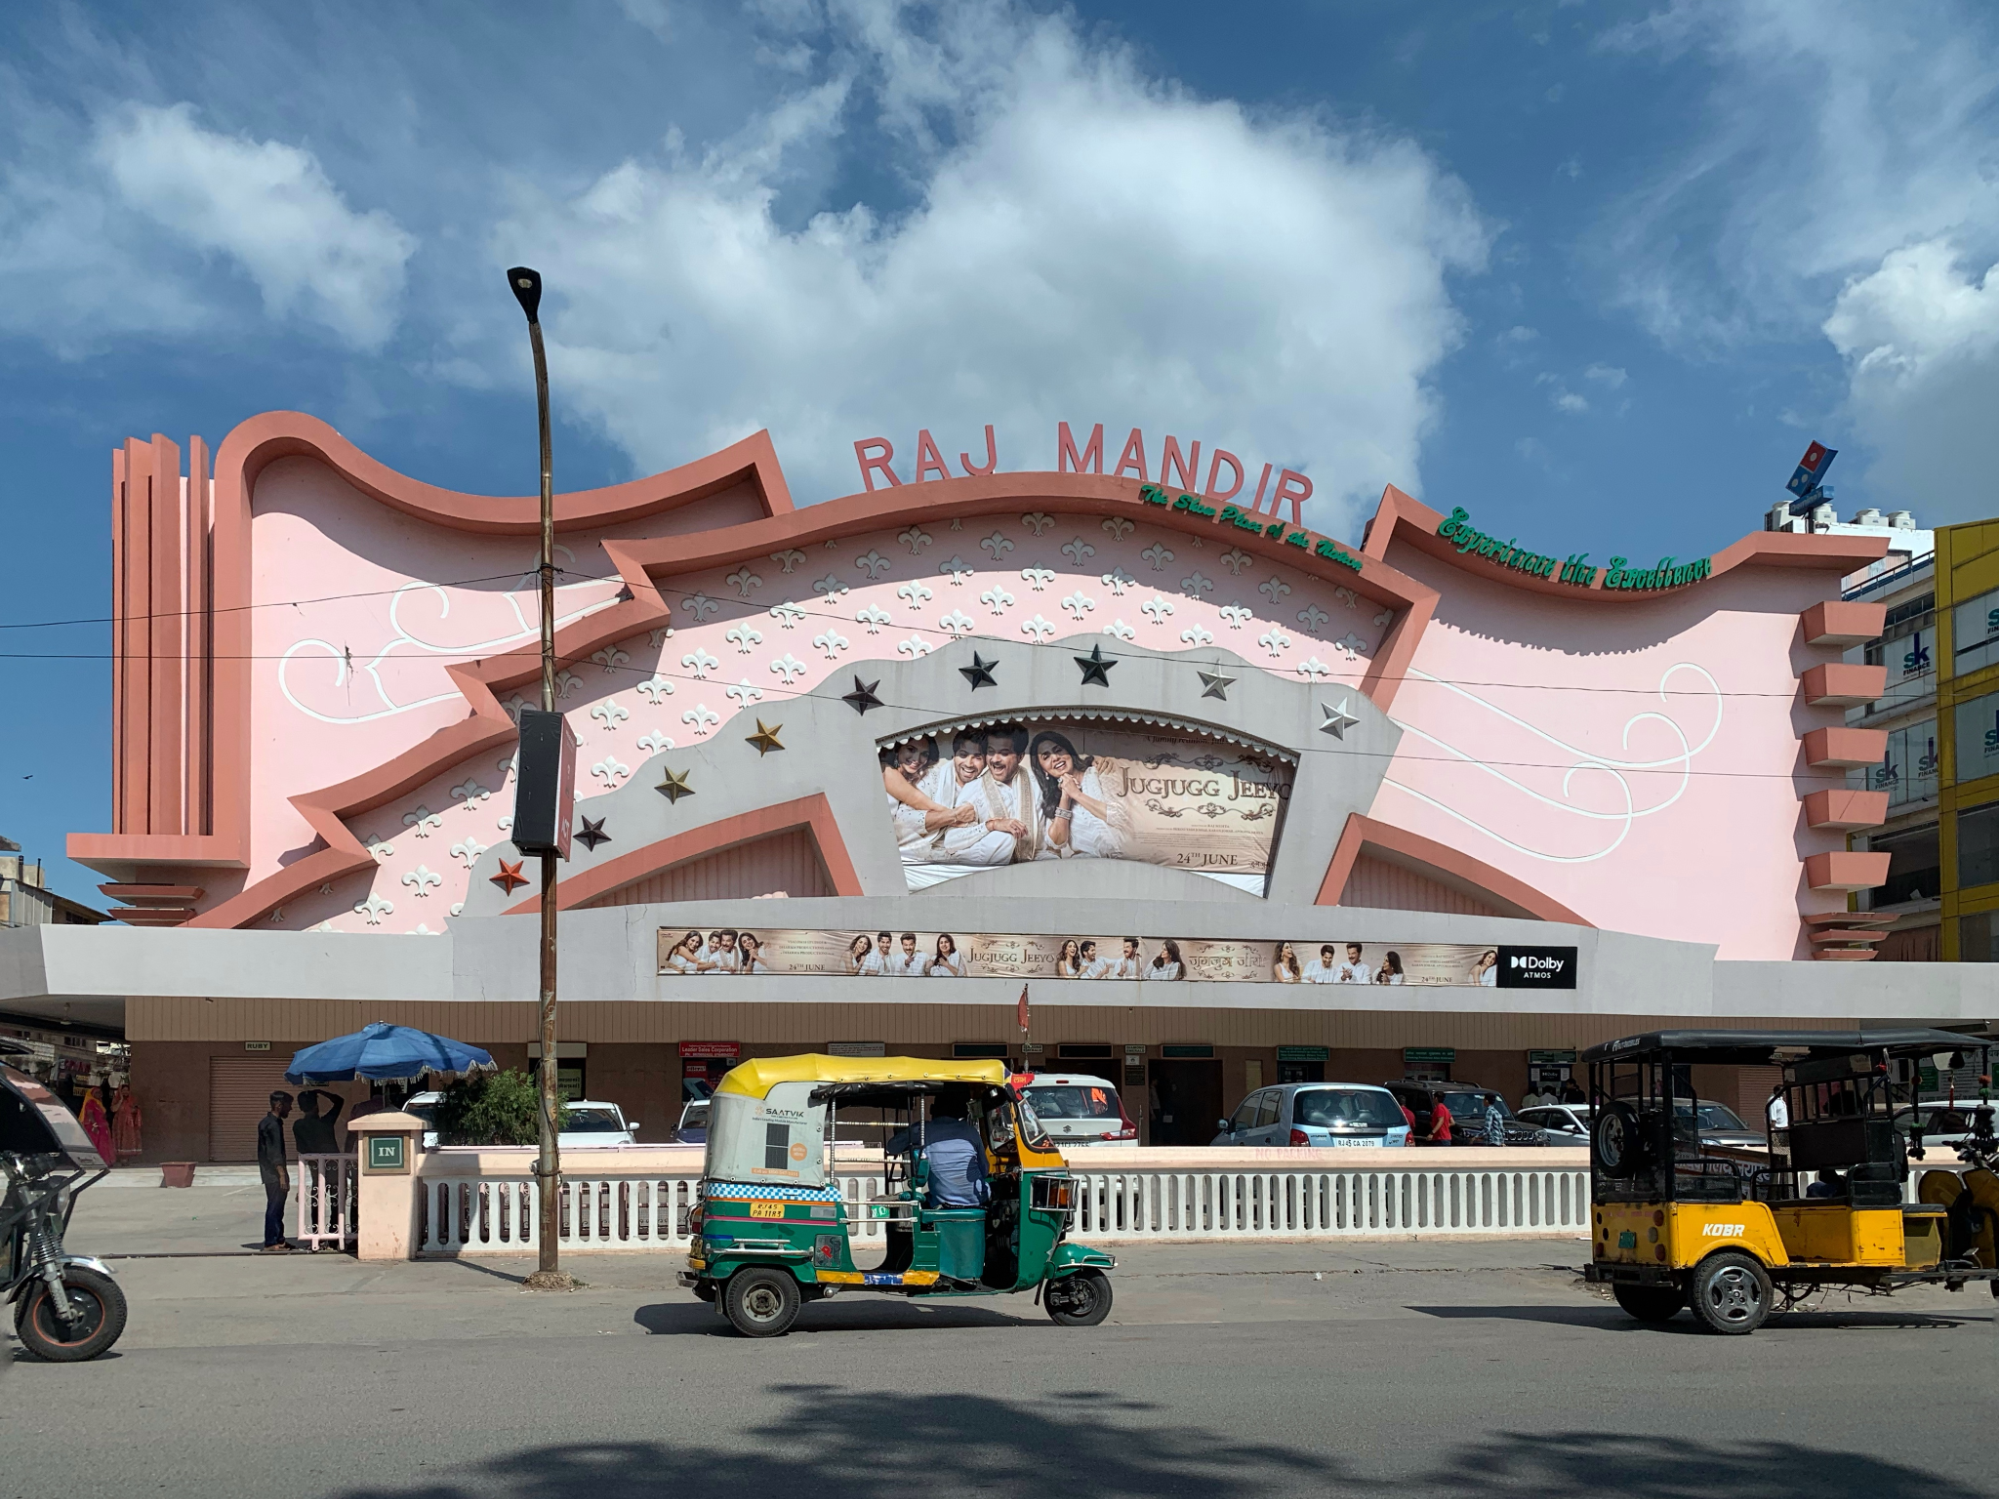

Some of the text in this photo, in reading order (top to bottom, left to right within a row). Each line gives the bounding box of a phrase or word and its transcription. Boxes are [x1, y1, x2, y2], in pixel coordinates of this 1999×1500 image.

[854, 421, 1314, 528] RAJ MANDIR
[1141, 485, 1363, 571] The Show Place of the Nation
[1439, 506, 1712, 588] Experience the Excellence
[1903, 661, 1931, 676] FINANCE
[1117, 766, 1220, 798] JUGJUGG
[1201, 853, 1238, 867] JUNE
[967, 946, 1055, 964] JUGJUGG JEEYO
[804, 964, 826, 972] JUNE
[1528, 956, 1565, 972] Dolby
[766, 1108, 804, 1117] SAATVIK
[378, 1147, 395, 1156] IN
[1702, 1223, 1745, 1237] KOBR
